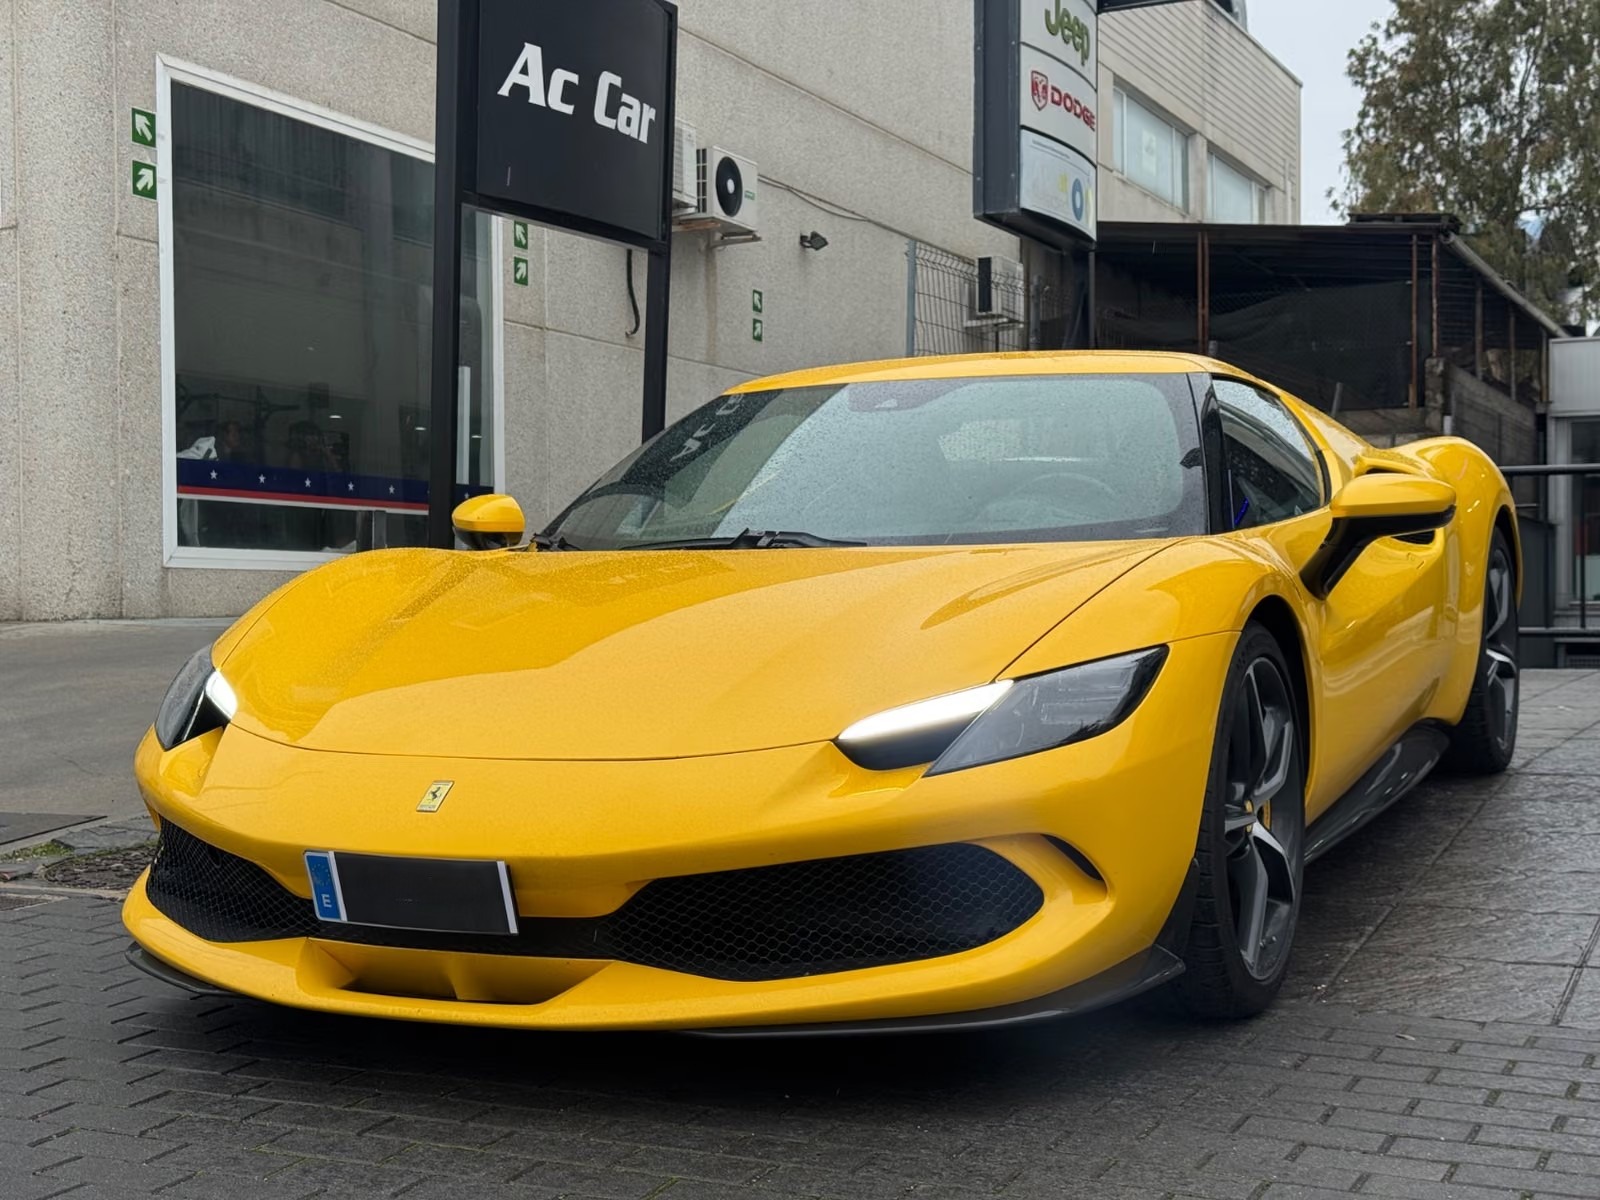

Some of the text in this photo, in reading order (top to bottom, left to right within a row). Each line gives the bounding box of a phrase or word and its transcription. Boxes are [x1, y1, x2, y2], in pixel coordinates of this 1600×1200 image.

[1044, 0, 1090, 66] Jeep
[497, 42, 656, 144] Ac Car
[1050, 85, 1096, 132] DODGE
[320, 893, 332, 908] E
